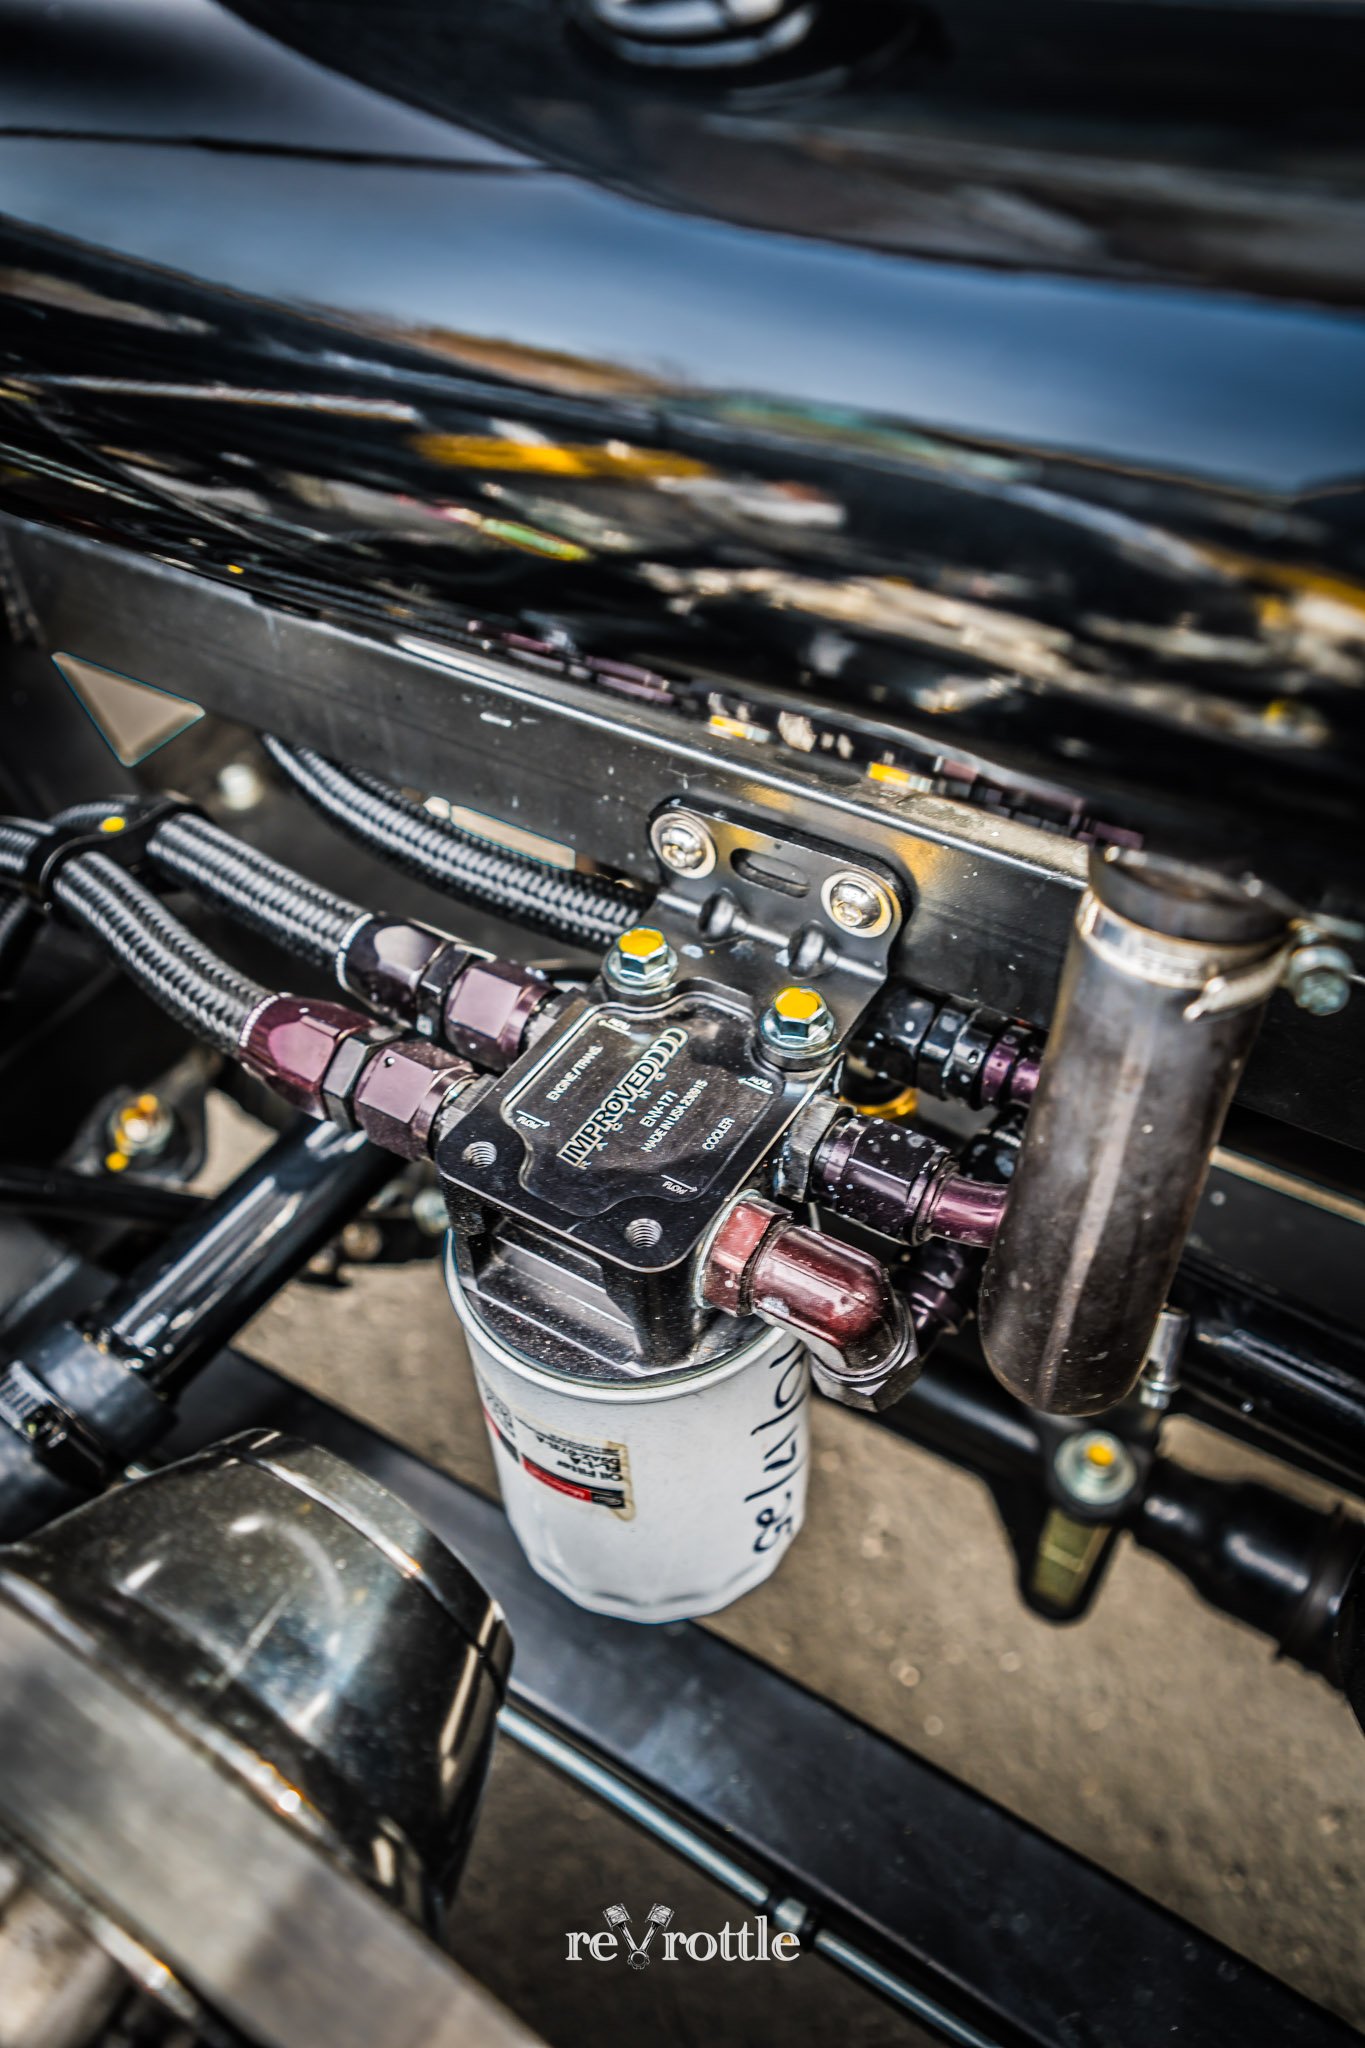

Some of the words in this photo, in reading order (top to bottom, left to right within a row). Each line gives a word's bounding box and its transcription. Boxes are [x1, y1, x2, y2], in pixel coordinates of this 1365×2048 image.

[639, 1090, 679, 1127] ENV-171
[641, 1128, 668, 1153] MADE
[661, 1117, 675, 1131] IN
[669, 1103, 689, 1123] USA
[702, 1116, 736, 1150] COOLER
[661, 1180, 689, 1195] FLOW
[600, 1470, 624, 1481] Oil
